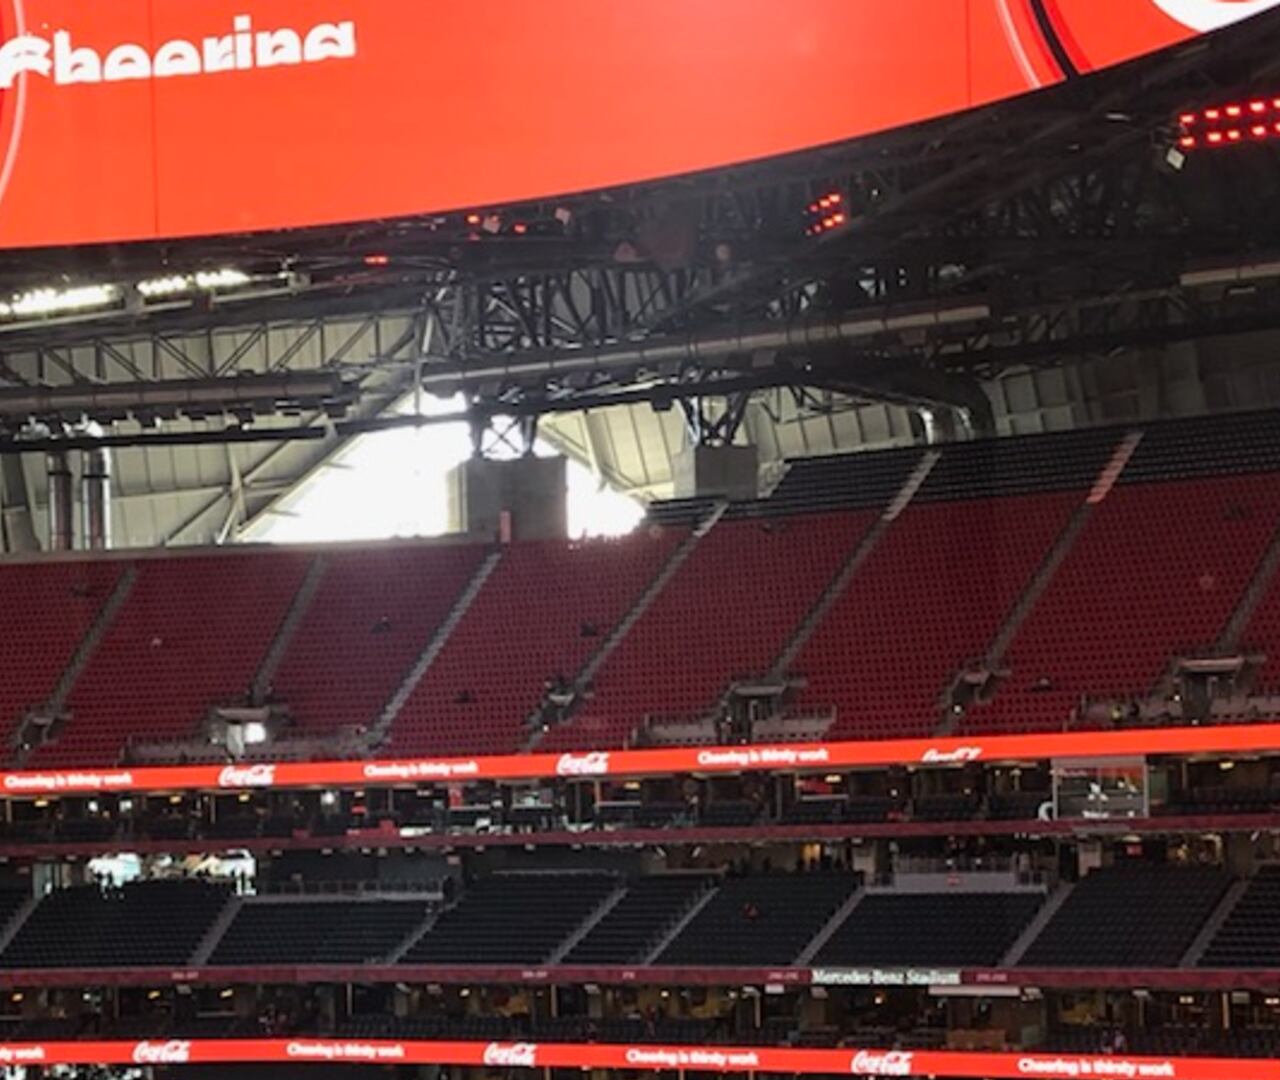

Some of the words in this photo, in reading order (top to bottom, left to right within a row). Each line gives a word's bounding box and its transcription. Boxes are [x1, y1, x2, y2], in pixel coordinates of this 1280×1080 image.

[557, 752, 609, 774] Coca-Cola
[219, 765, 275, 786] Coca-Cola
[812, 970, 902, 984] Mercedes-Benz
[906, 970, 960, 984] Stadium
[133, 1041, 190, 1062] Coca-Cola
[484, 1043, 536, 1065] Coca-Cola
[852, 1051, 912, 1075] Coca-Cola
